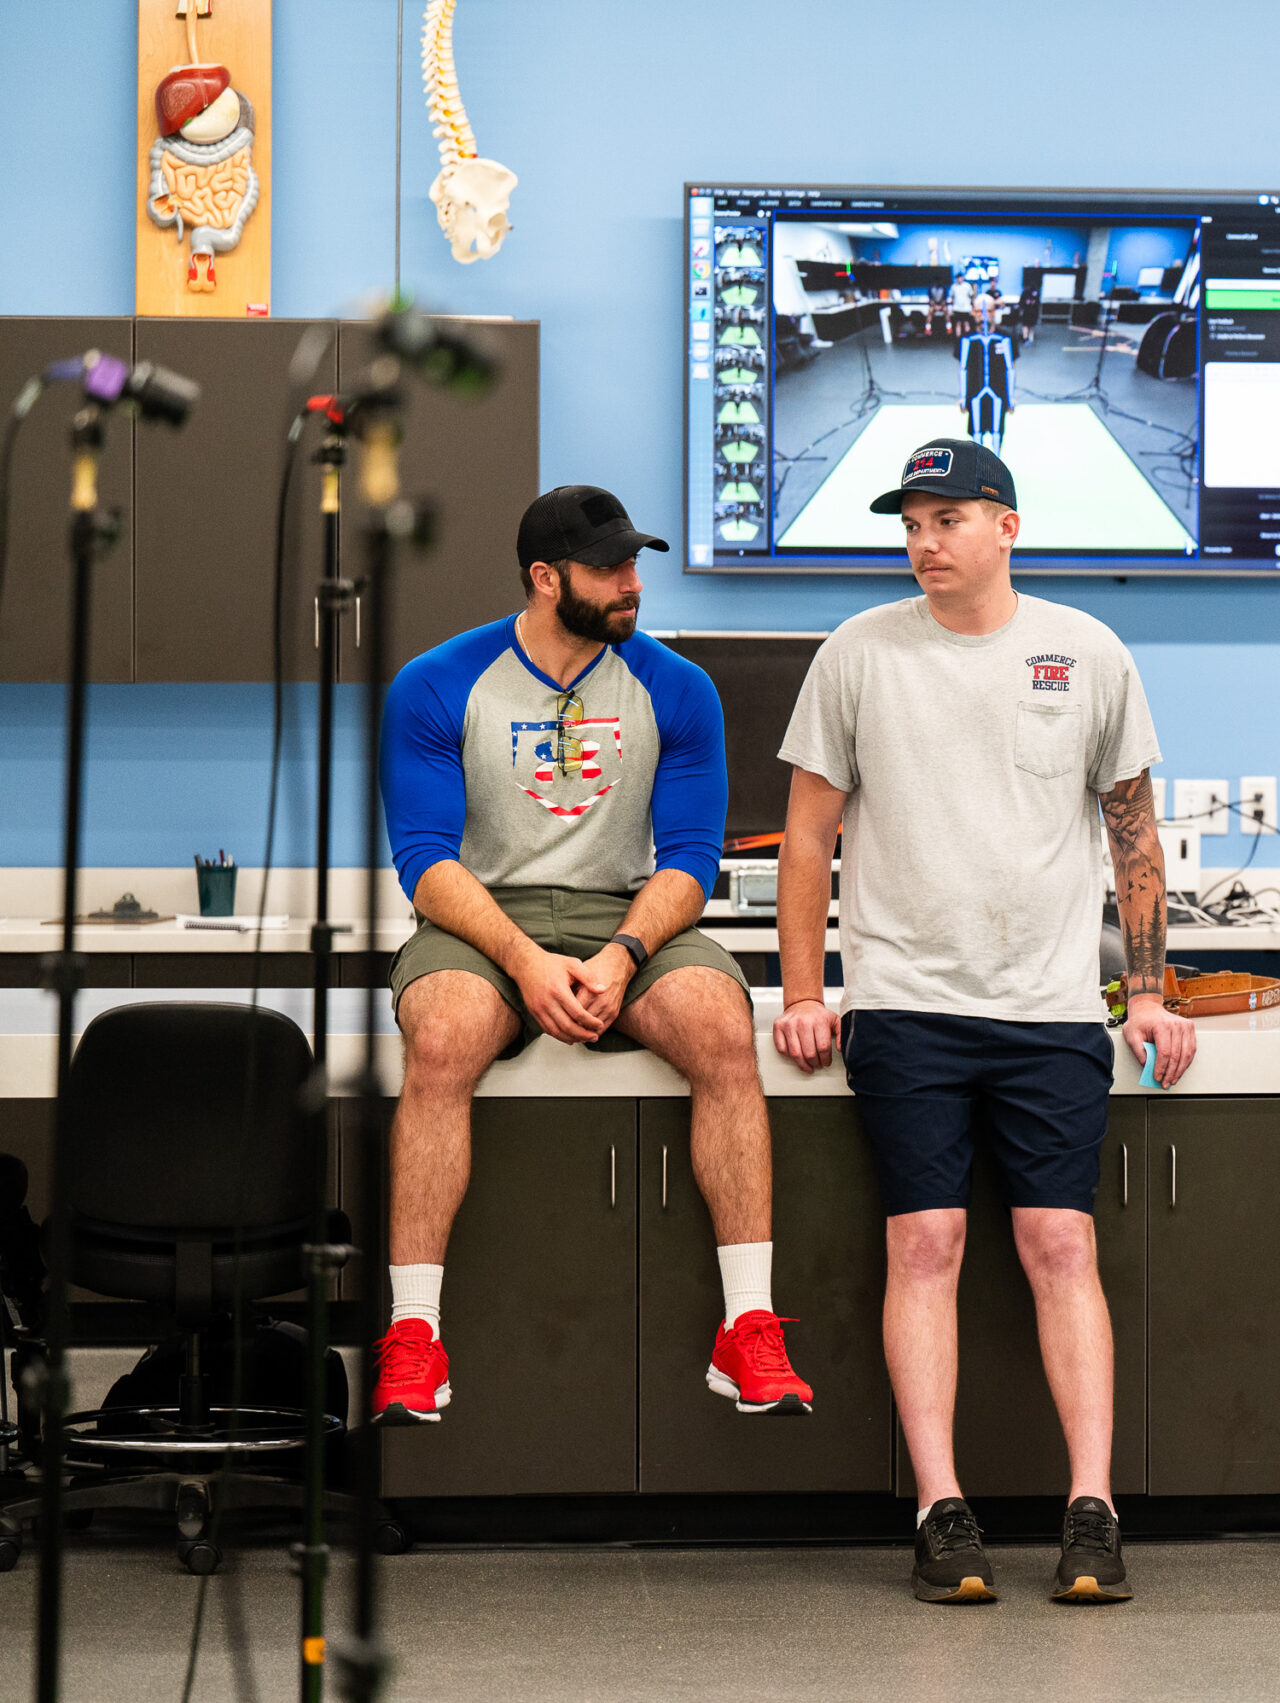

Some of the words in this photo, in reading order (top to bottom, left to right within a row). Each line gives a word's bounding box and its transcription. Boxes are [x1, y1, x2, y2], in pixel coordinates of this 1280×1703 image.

[911, 451, 943, 462] COMMERCE
[913, 457, 934, 471] 214
[1025, 654, 1077, 668] COMMERCE
[1033, 665, 1069, 681] FIRE
[1032, 680, 1070, 691] RESCUE
